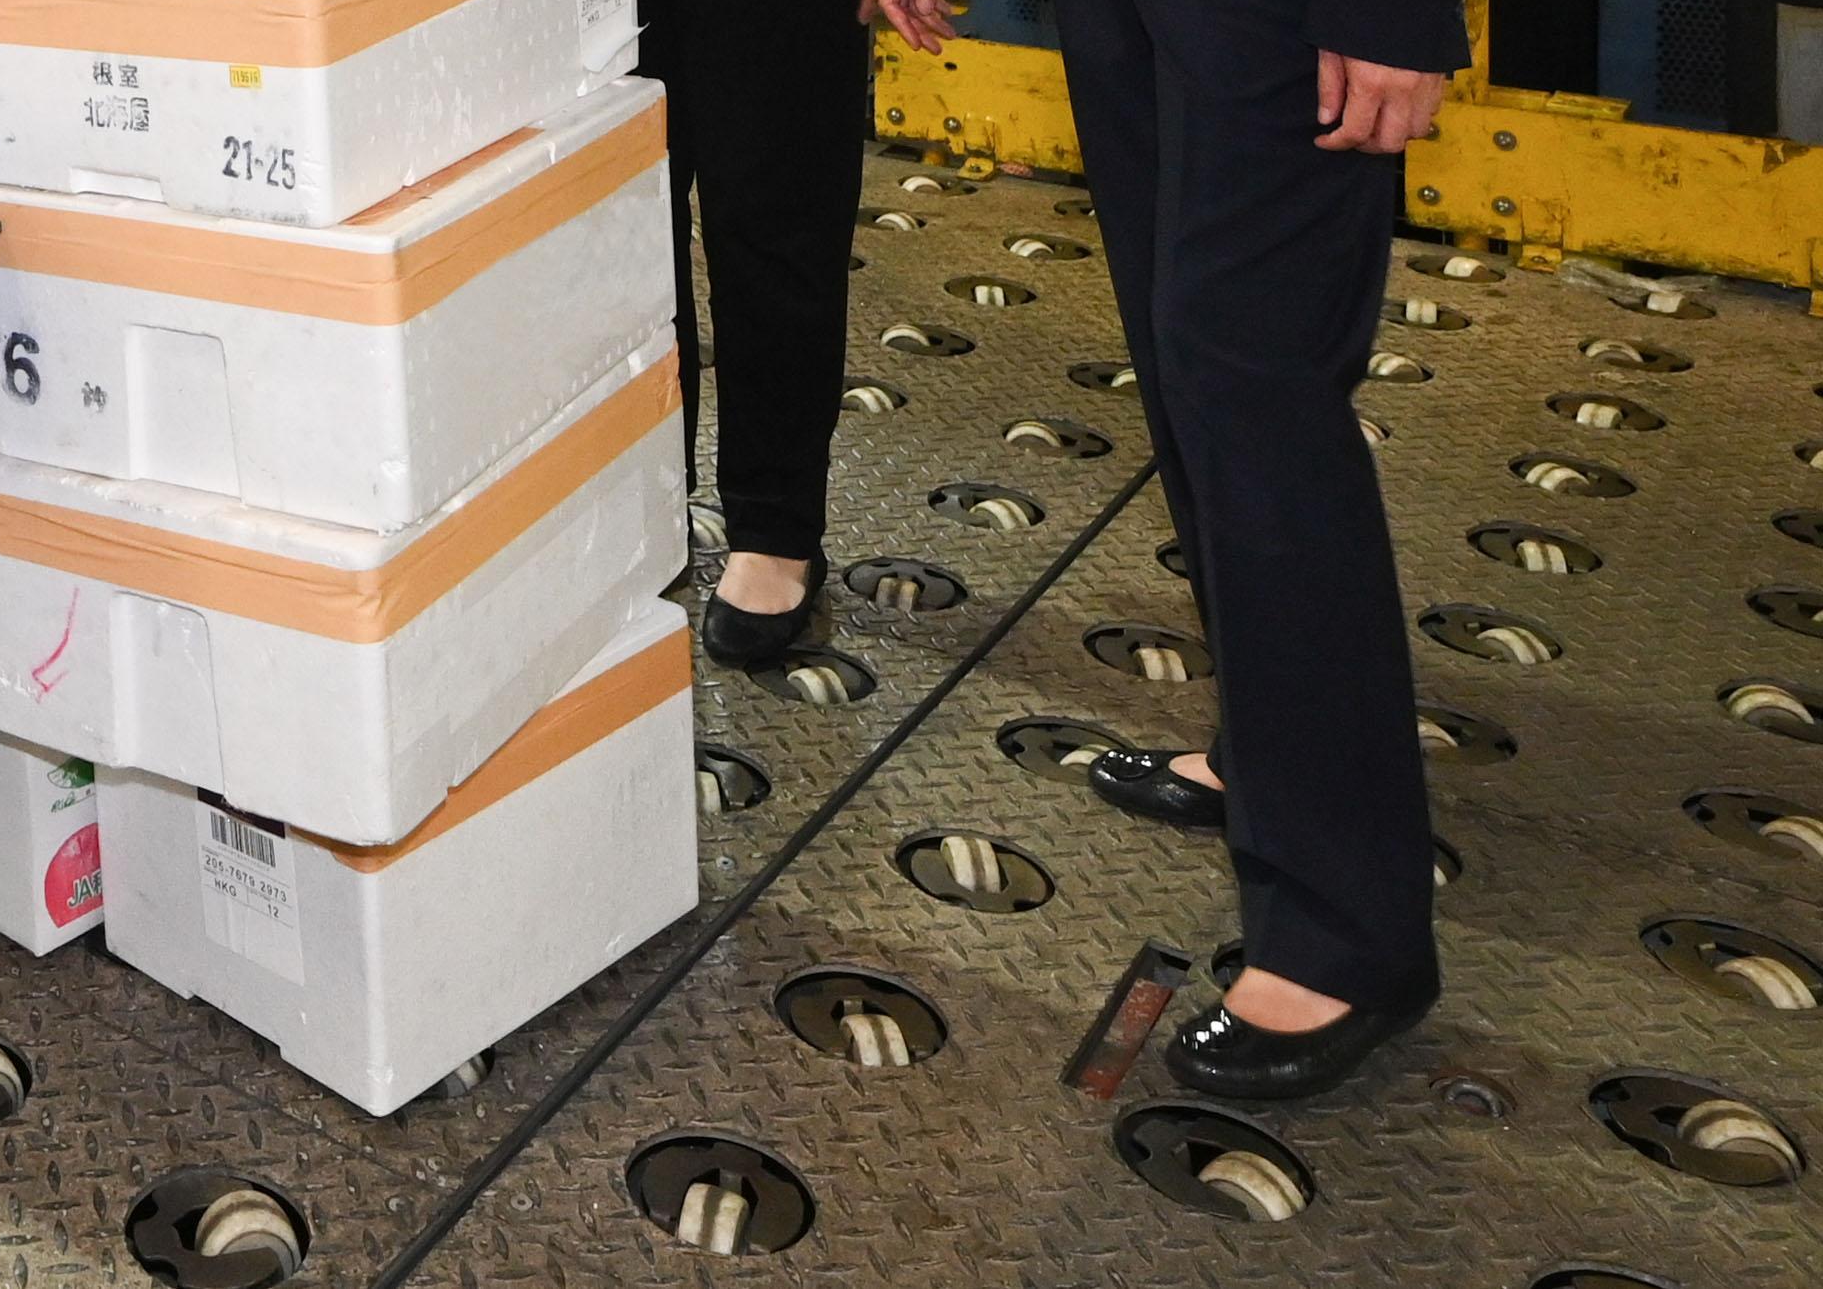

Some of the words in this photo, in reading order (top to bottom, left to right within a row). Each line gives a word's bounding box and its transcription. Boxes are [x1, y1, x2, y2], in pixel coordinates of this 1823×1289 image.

[221, 135, 296, 190] 21-25
[3, 331, 41, 406] 6
[267, 903, 280, 919] 12
